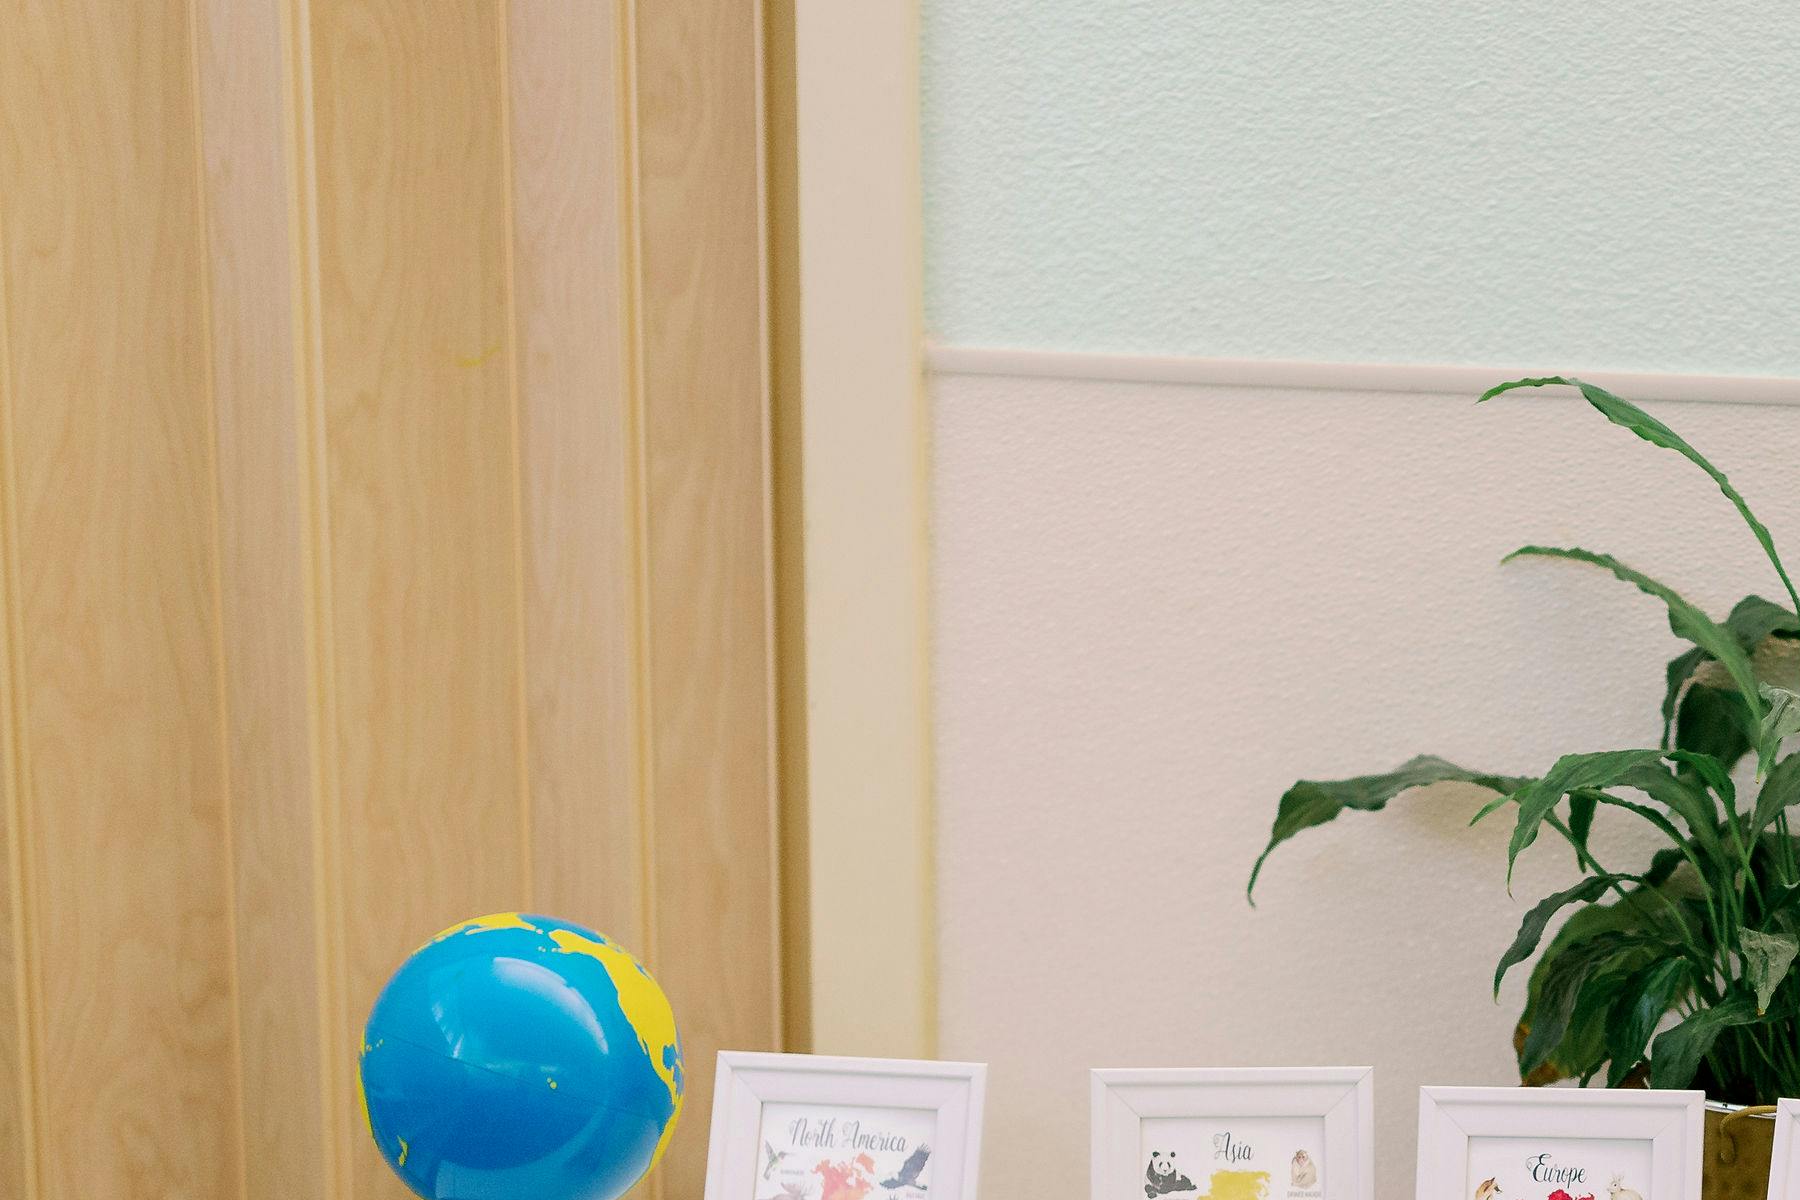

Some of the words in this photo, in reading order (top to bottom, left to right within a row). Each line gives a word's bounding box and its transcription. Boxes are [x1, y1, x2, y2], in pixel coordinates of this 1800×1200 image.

[790, 1117, 836, 1149] North
[843, 1119, 908, 1153] America
[1213, 1131, 1255, 1164] Asia
[1525, 1153, 1587, 1189] Europe
